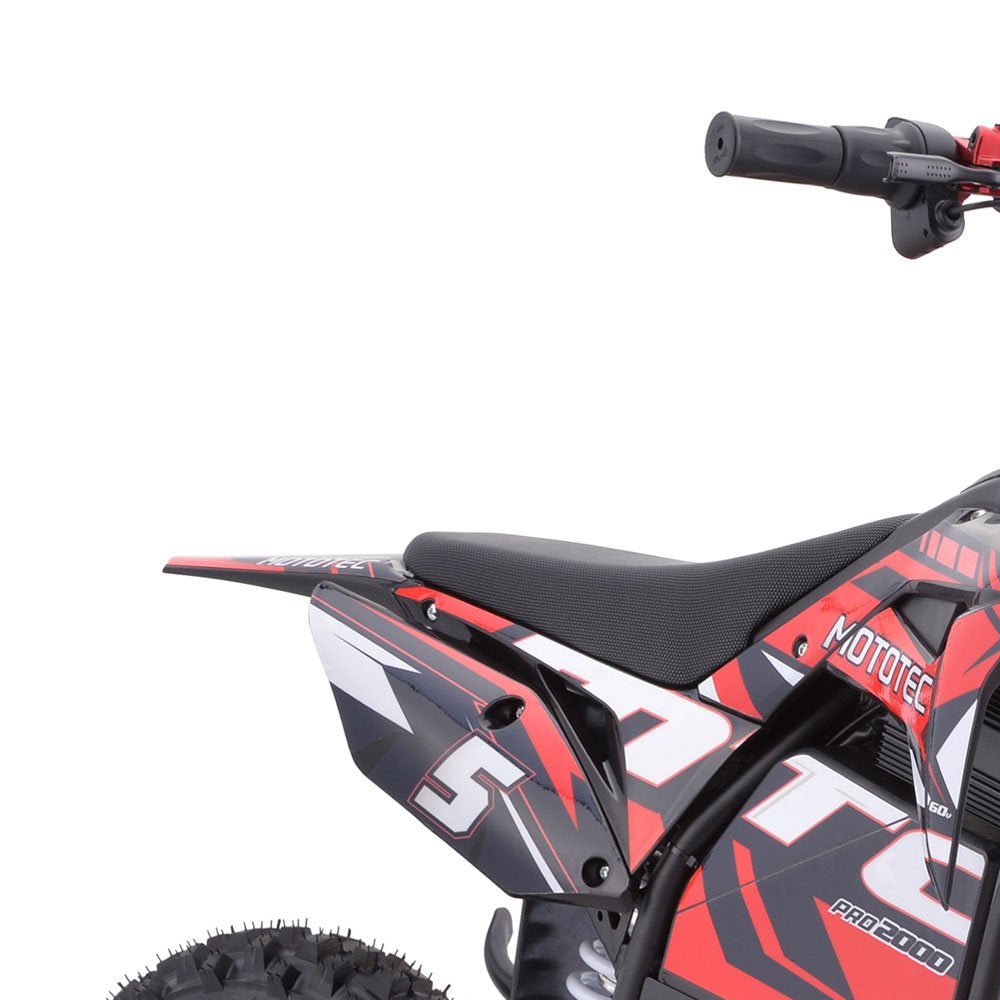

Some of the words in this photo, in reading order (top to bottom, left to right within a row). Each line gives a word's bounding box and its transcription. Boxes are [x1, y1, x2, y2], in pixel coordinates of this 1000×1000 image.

[255, 557, 381, 570] MOTOTEC
[821, 613, 934, 715] MOTOTEC
[411, 733, 530, 836] 5
